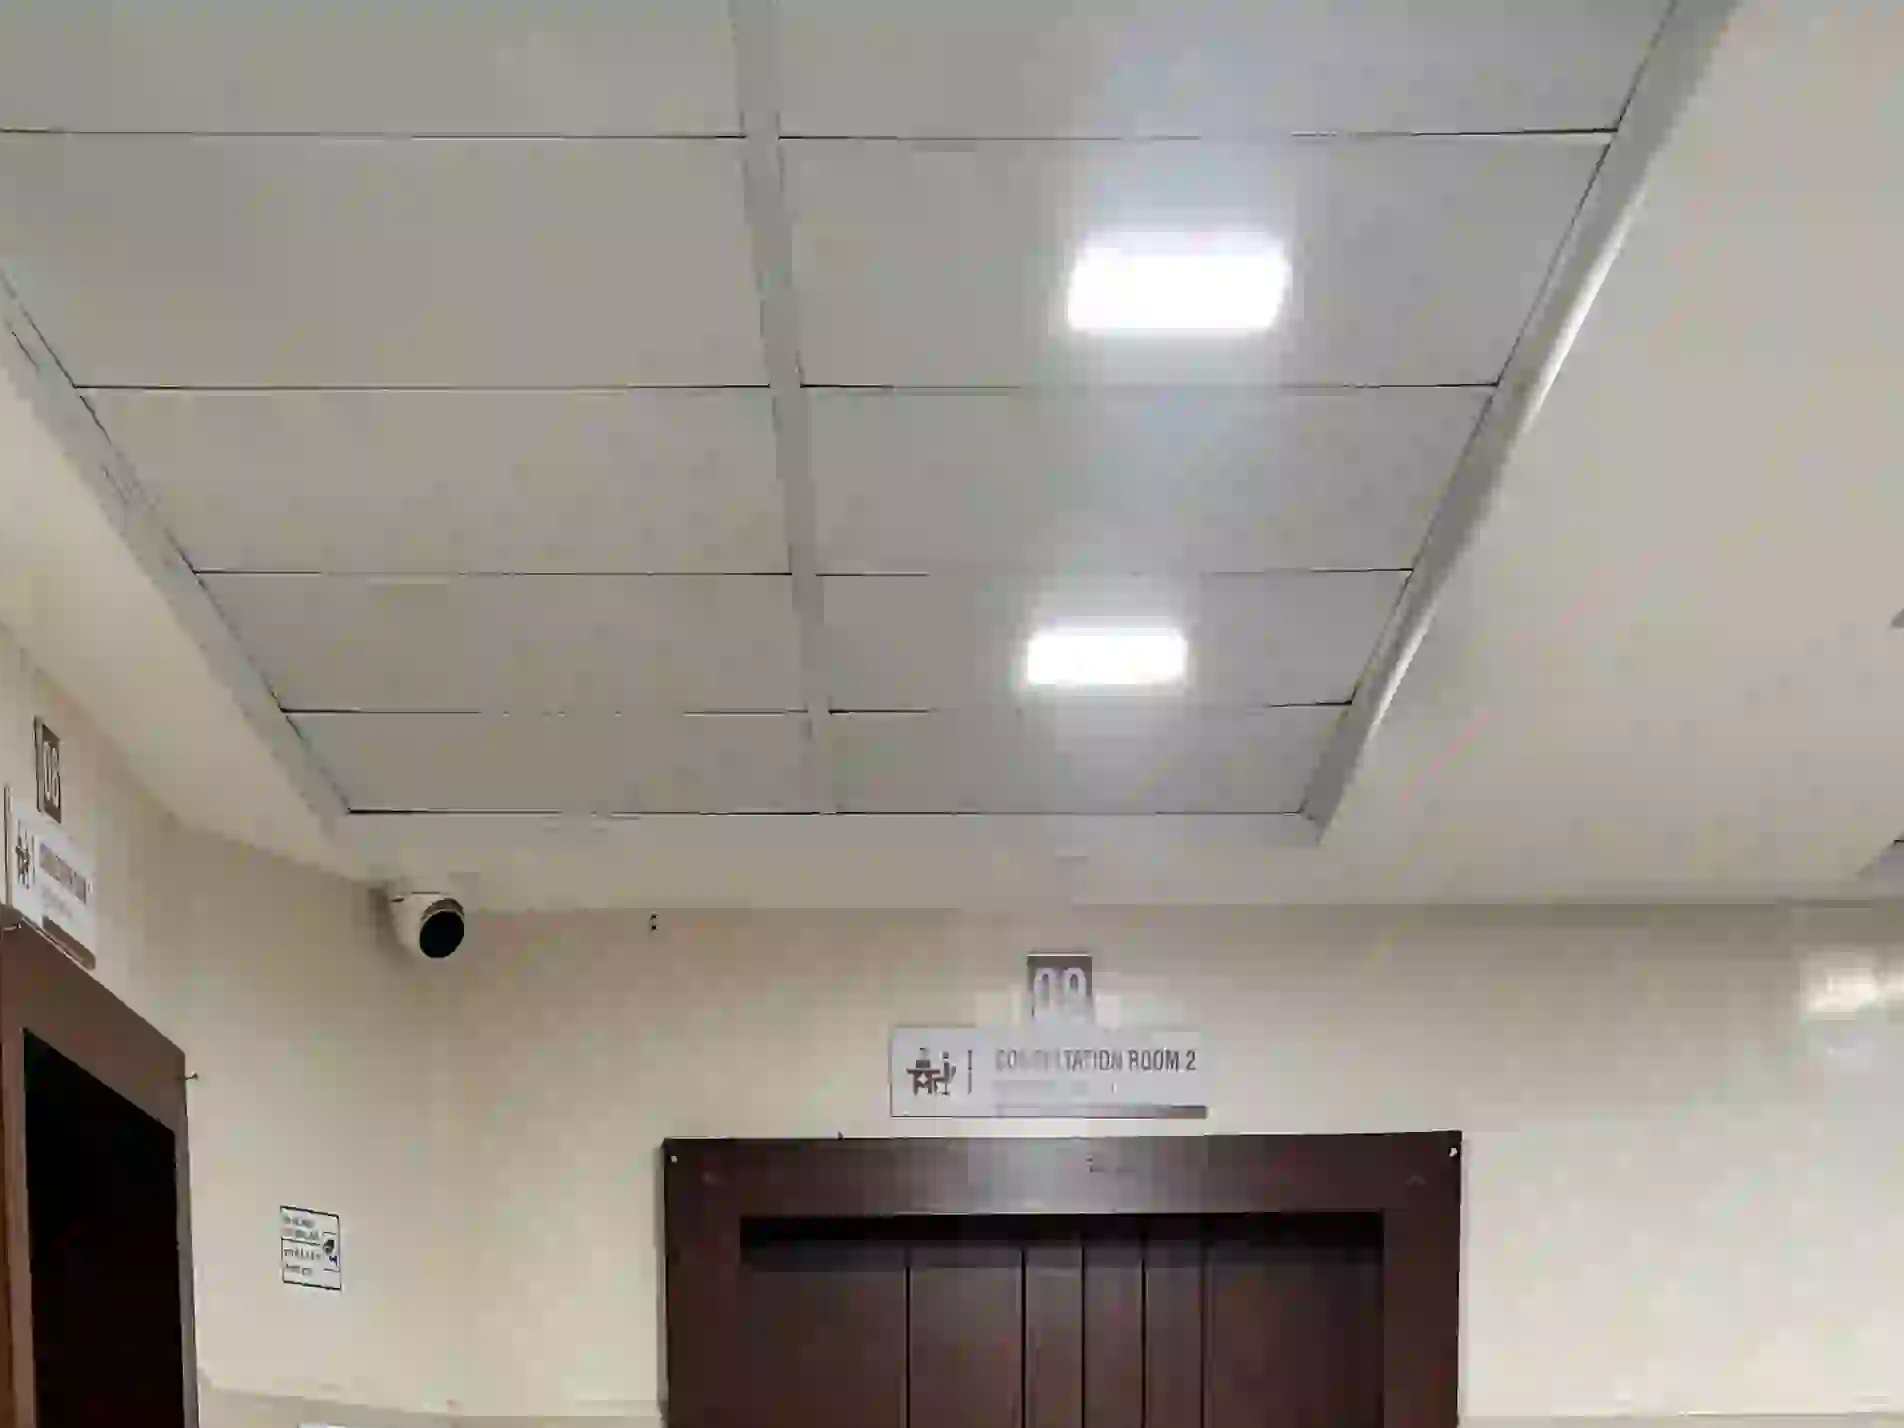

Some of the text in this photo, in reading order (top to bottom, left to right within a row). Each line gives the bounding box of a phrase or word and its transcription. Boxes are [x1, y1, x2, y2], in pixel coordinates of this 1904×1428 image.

[995, 1049, 1197, 1072] COLTATION ROOM 2
